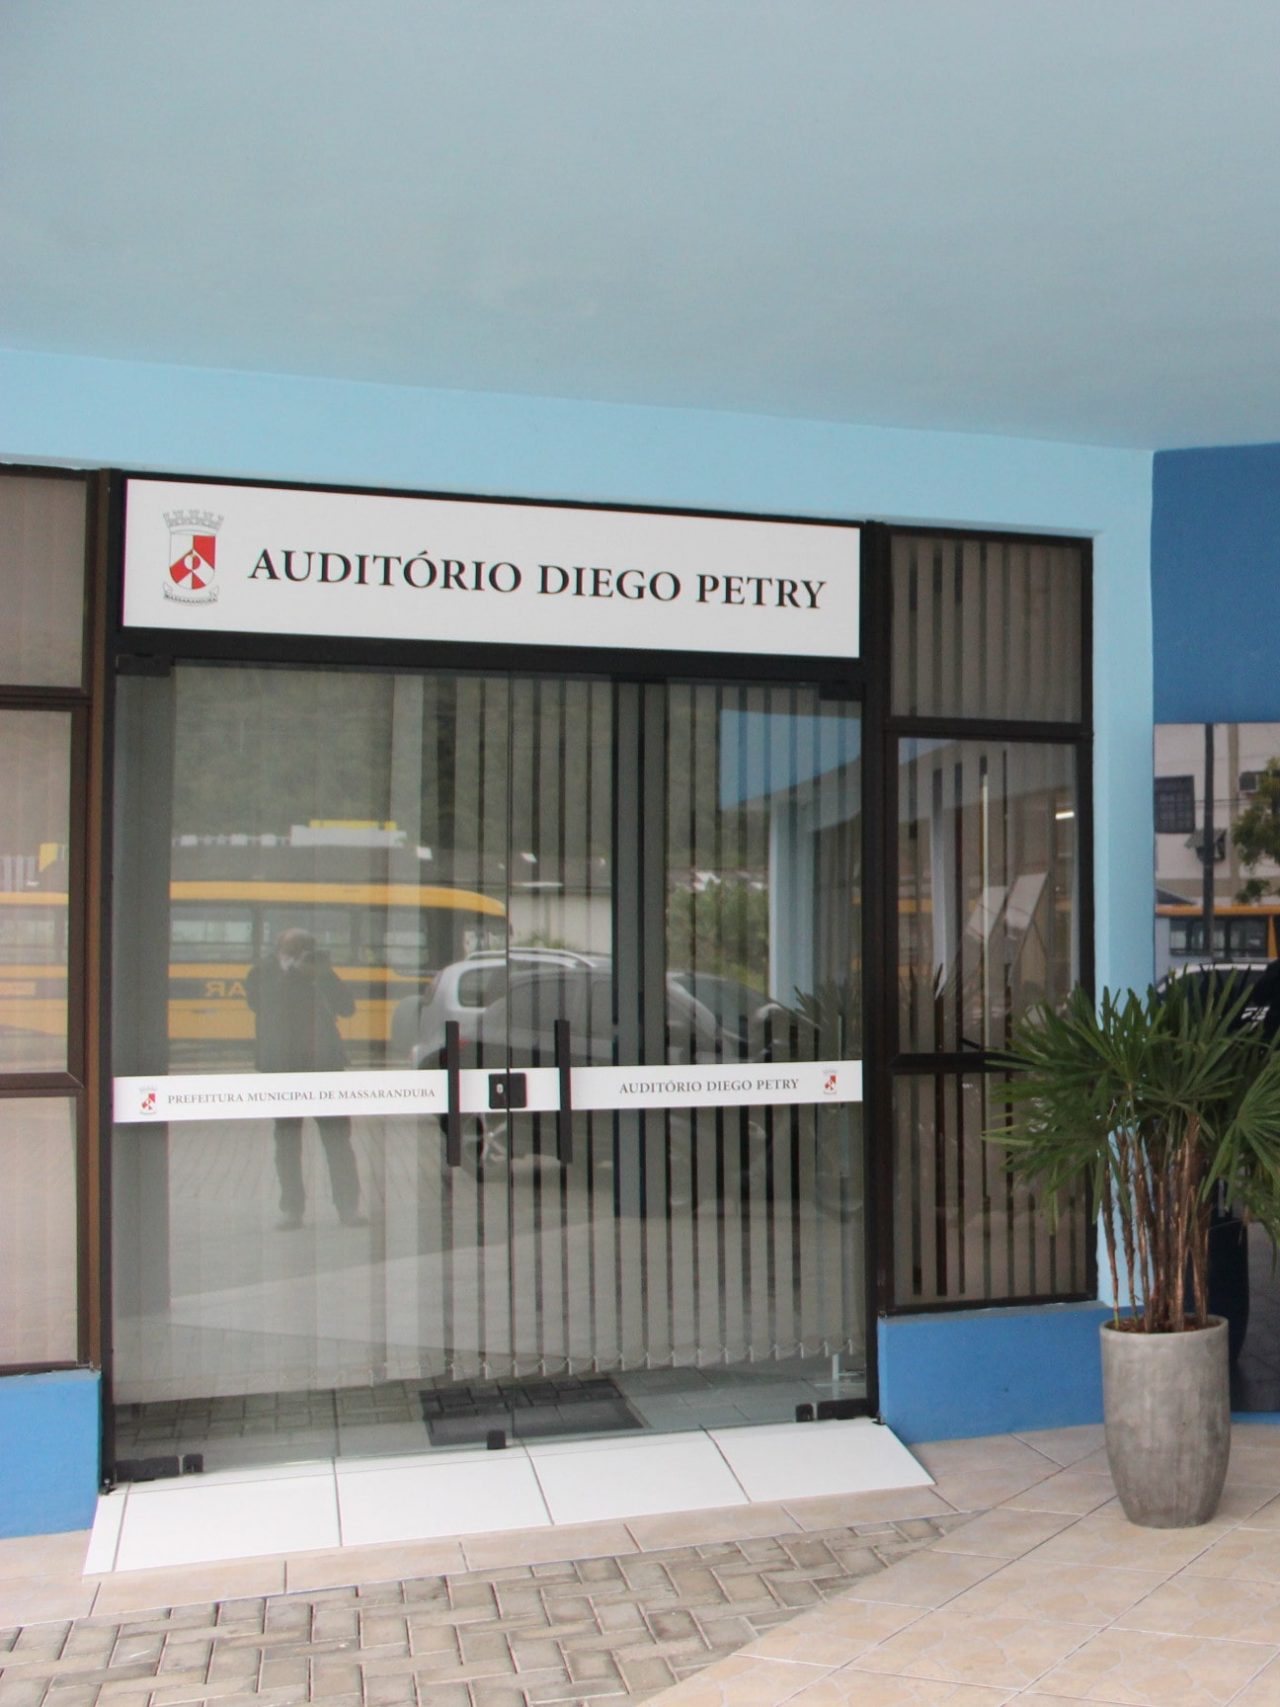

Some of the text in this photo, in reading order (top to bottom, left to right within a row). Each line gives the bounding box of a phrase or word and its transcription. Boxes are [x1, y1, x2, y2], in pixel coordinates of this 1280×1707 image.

[248, 548, 826, 609] AUDITÓRIO DIEGO PETRY
[619, 1078, 800, 1095] AUDITÓRIO DIEGO PETRY
[168, 1088, 436, 1104] PREFEITURA MUNICIPAL DE MASSARANDUBA
